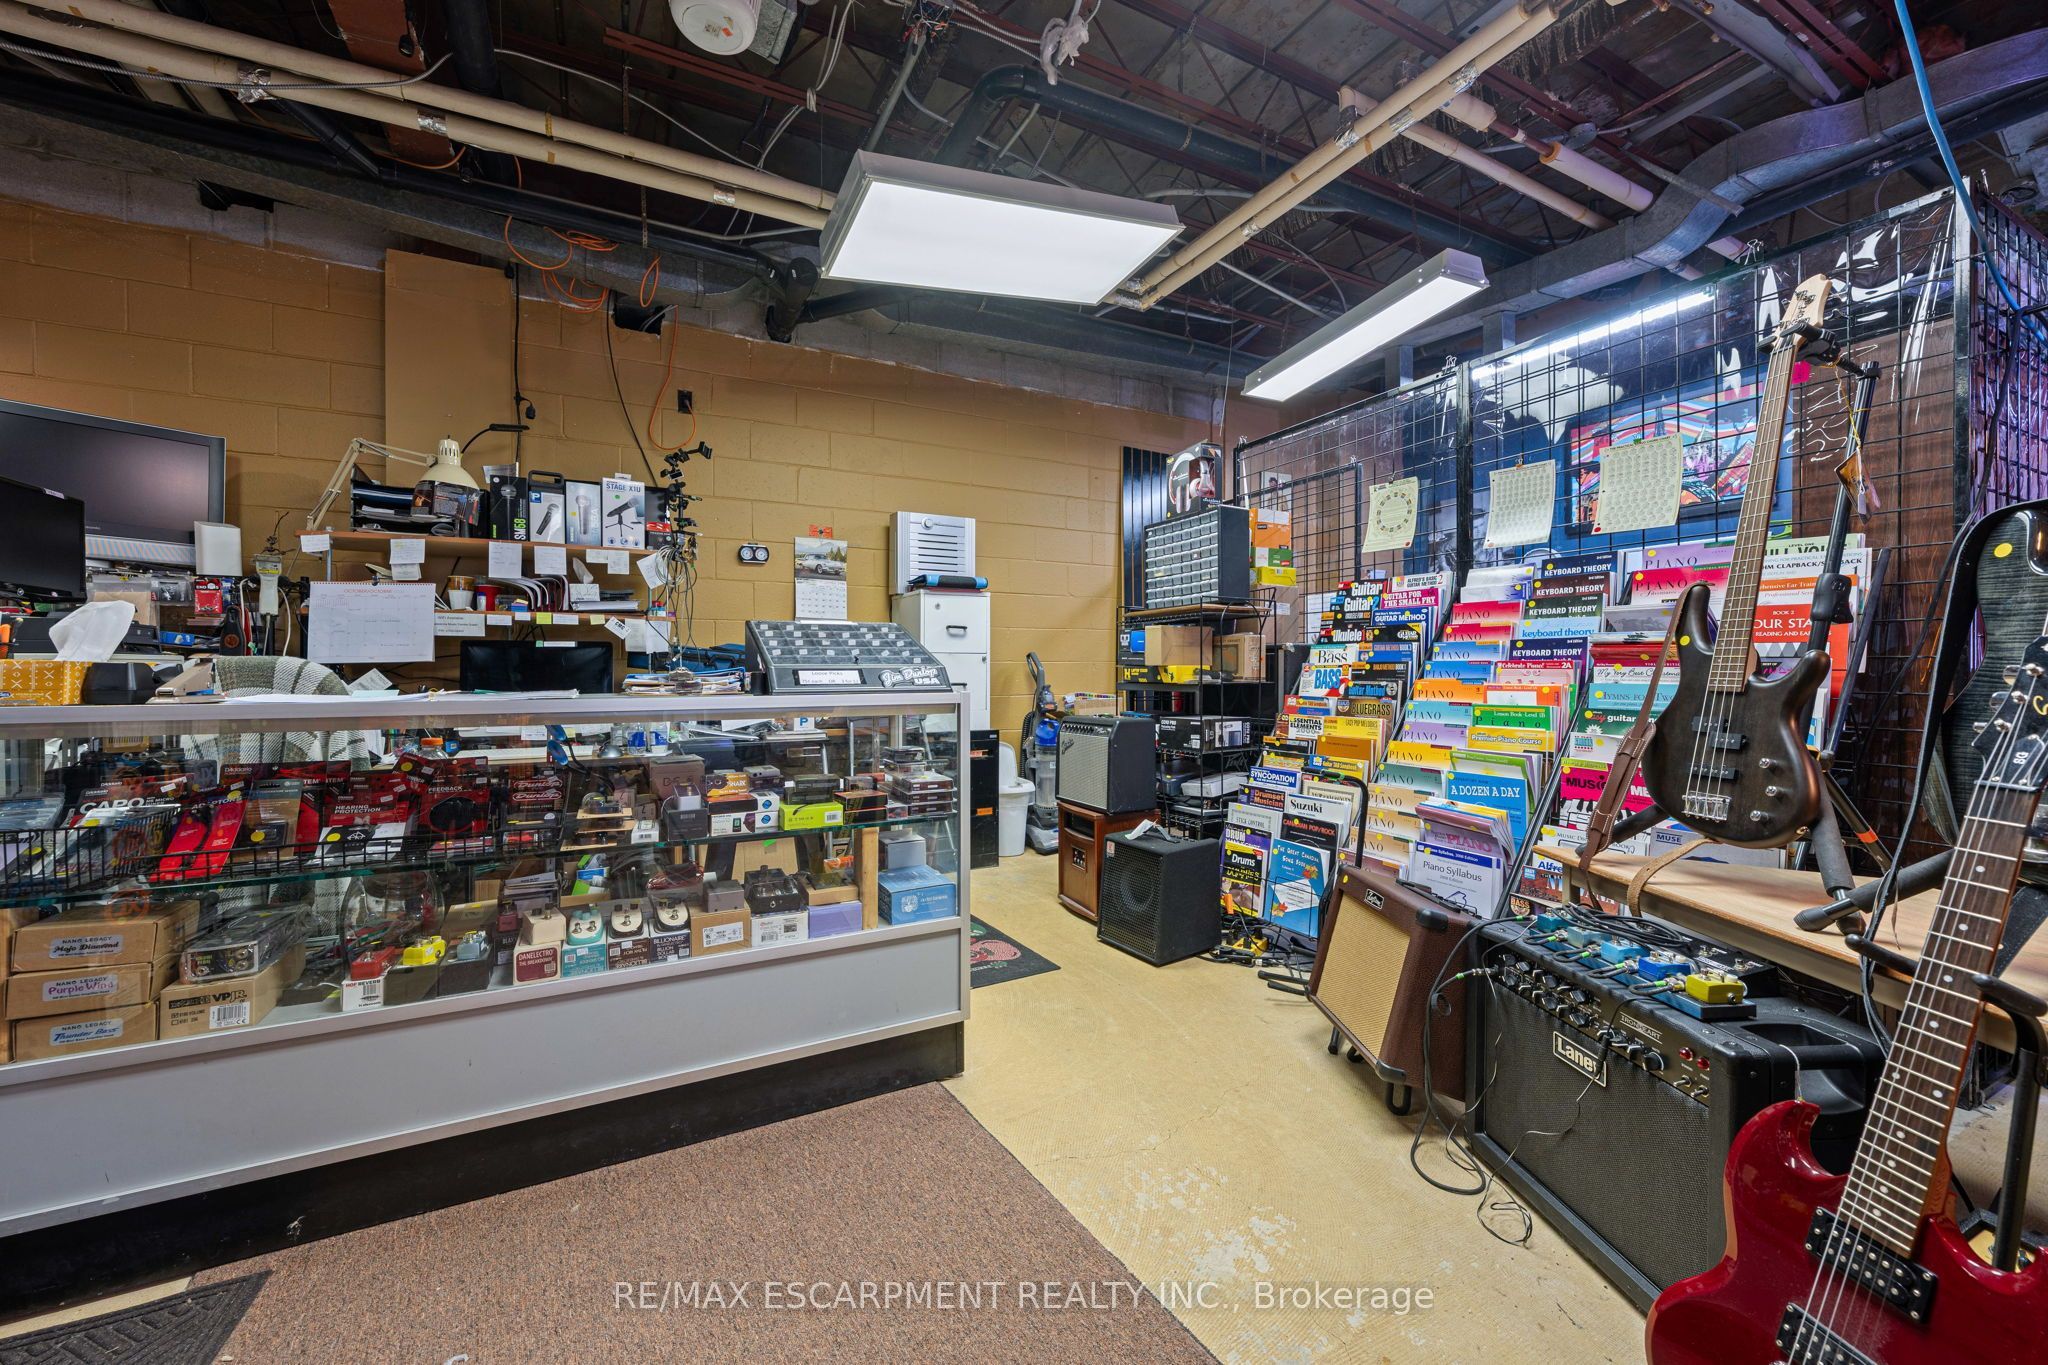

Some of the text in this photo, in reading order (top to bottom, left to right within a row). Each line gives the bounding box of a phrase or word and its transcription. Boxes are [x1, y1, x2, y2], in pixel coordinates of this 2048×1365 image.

[606, 483, 627, 491] STAGE
[1646, 556, 1698, 570] PIANO
[1544, 563, 1612, 577] KEYBOARD THEORY
[1437, 575, 1443, 585] 2
[1635, 579, 1688, 592] PIANO
[1351, 582, 1383, 597] Guitar
[1408, 591, 1422, 599] FOR
[1536, 584, 1605, 596] KEYBOARD THEORY
[1344, 597, 1374, 612] Guitar
[1384, 596, 1436, 607] THE SMALL FRY
[1454, 609, 1490, 620] PIANO
[1529, 605, 1598, 616] KEYBOARD THEORY
[1375, 613, 1427, 622] GUITAR METHOD
[1332, 628, 1362, 642] Ukulele
[1445, 633, 1482, 642] PIANO
[1522, 627, 1595, 638] keyboard theory
[1318, 650, 1348, 664] Bass
[1433, 652, 1470, 660] PIANO
[1512, 648, 1583, 657] KEYBOARD THEORY
[1314, 668, 1342, 690] BASS
[1425, 670, 1461, 679] PIANO
[914, 678, 941, 686] USA
[1418, 689, 1454, 699] PIANO
[1351, 702, 1391, 716] BLUEGRASS
[1407, 711, 1442, 720] PIANO
[1607, 714, 1637, 723] guitar
[1290, 722, 1322, 731] ELEMENTS
[1403, 731, 1438, 741] PIANO
[1471, 734, 1497, 742] Premier
[1389, 752, 1423, 762] PIANO
[1250, 770, 1295, 784] SYNCOPATION
[1379, 774, 1414, 785] PIANO
[428, 785, 463, 794] FEEDBACK
[514, 791, 562, 799] Dunlop
[1254, 789, 1285, 800] Drumset
[1451, 785, 1521, 798] A DOZEN A DAY
[79, 797, 146, 815] CAPO
[1253, 797, 1284, 808] Musician
[1290, 799, 1323, 813] Suzuki
[1369, 794, 1403, 807] PIANO
[1225, 828, 1246, 840] DRUM
[1656, 834, 1682, 843] MUSE
[1446, 834, 1493, 852] PIANO
[1231, 853, 1256, 866] Drums
[1423, 861, 1482, 882] Piano Syllabus
[1511, 896, 1530, 908] BASS
[518, 949, 553, 960] DANELECTRO
[79, 976, 108, 984] LEGACY
[48, 985, 84, 996] Purple
[213, 992, 230, 1002] VP
[53, 1031, 92, 1042] Thunder
